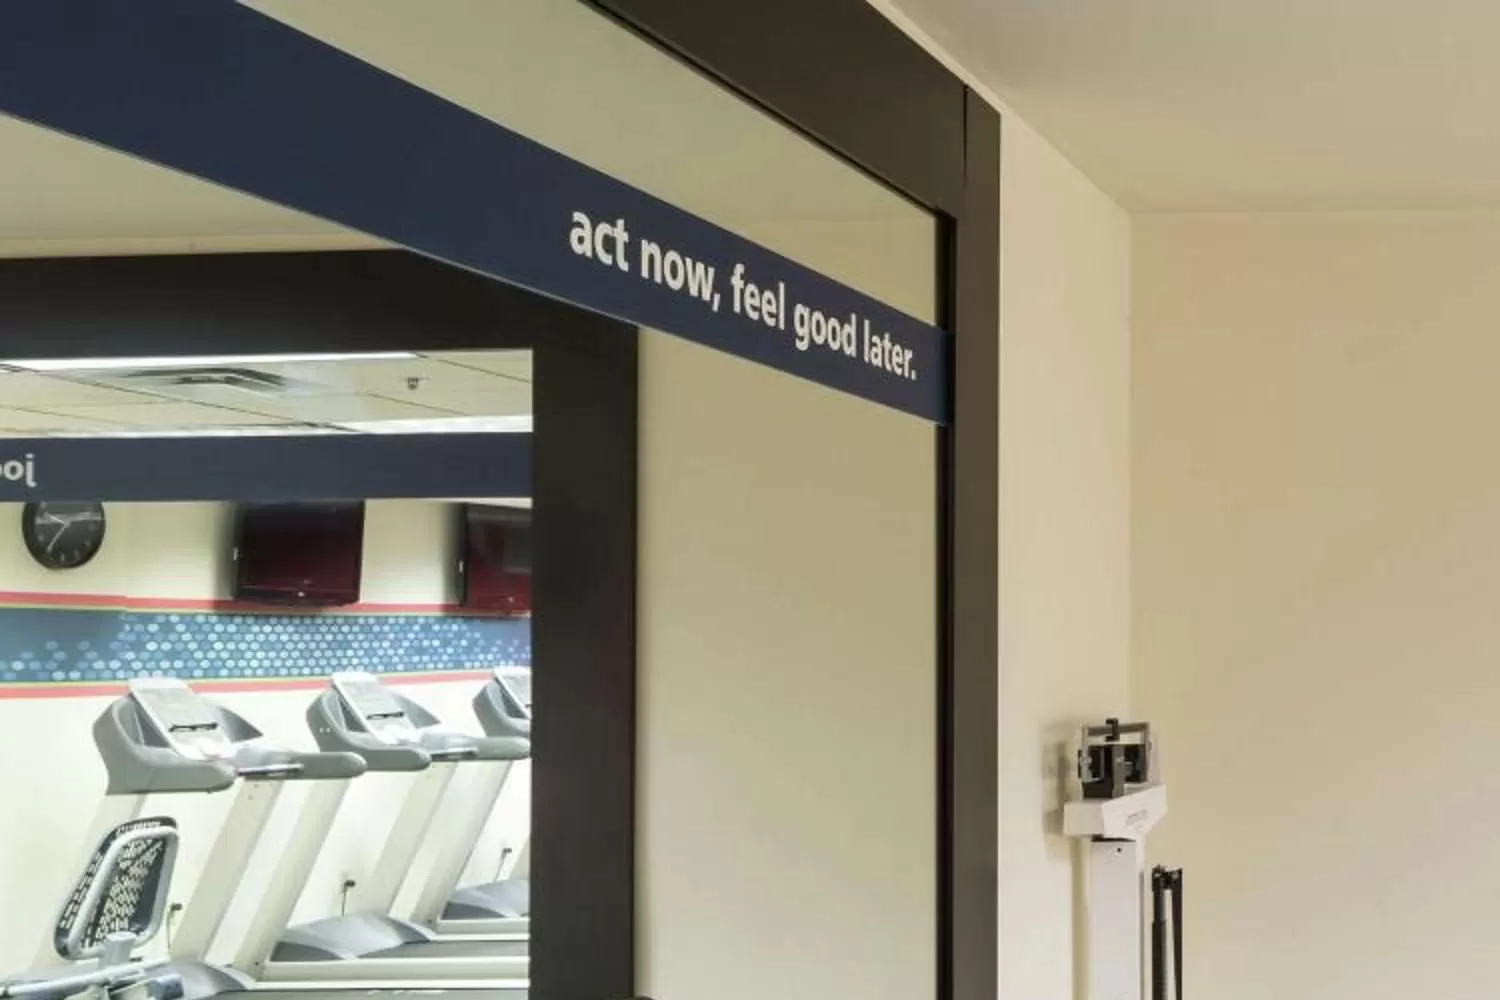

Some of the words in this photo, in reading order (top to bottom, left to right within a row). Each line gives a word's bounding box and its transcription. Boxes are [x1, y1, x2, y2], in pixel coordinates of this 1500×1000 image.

[569, 211, 629, 272] act
[641, 238, 721, 312] now,
[731, 263, 785, 331] feel
[794, 303, 857, 358] good
[863, 319, 917, 381] later.
